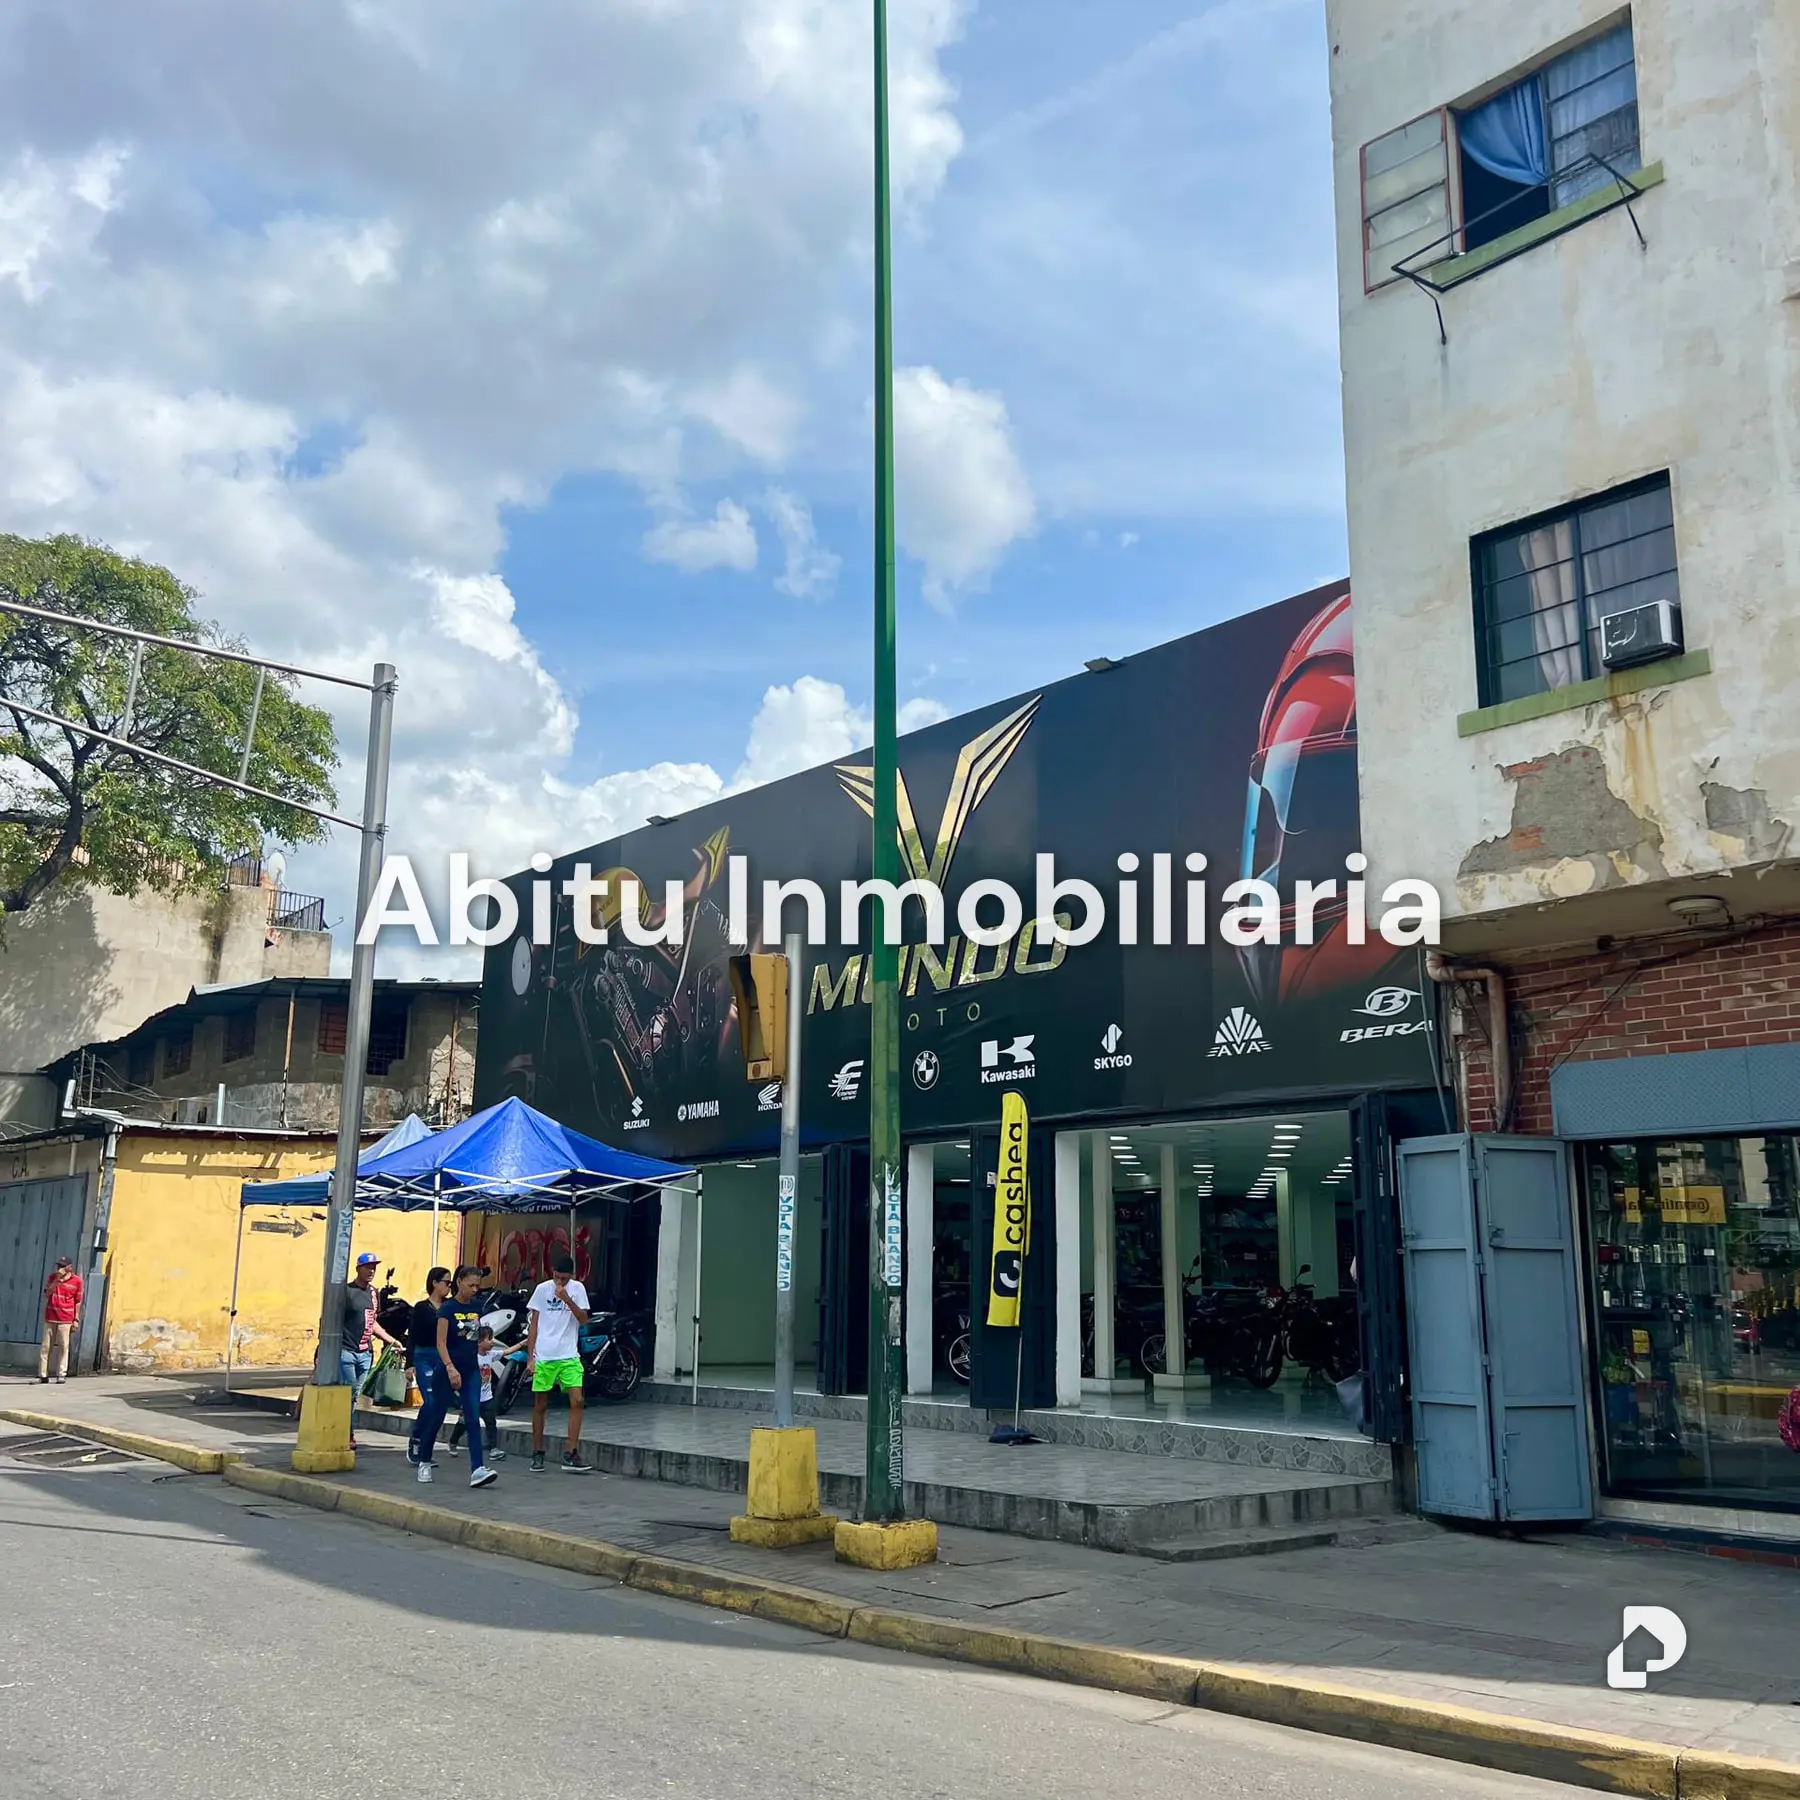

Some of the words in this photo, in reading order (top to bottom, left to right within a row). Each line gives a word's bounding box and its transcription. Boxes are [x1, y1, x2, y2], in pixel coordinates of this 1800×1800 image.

[906, 1001, 981, 1032] OTO
[1340, 1019, 1434, 1044] BERA
[1094, 1054, 1133, 1070] SKYGO
[1217, 1042, 1262, 1057] AVA
[981, 1064, 1036, 1084] Kawasaki
[623, 1118, 650, 1130] SUZUKI
[687, 1100, 720, 1121] YAMAHA
[1001, 1122, 1025, 1245] cashea
[779, 1195, 793, 1231] VOTA
[887, 1182, 901, 1221] VOTA
[476, 1224, 594, 1284] OTOS
[887, 1226, 901, 1284] BLANCO
